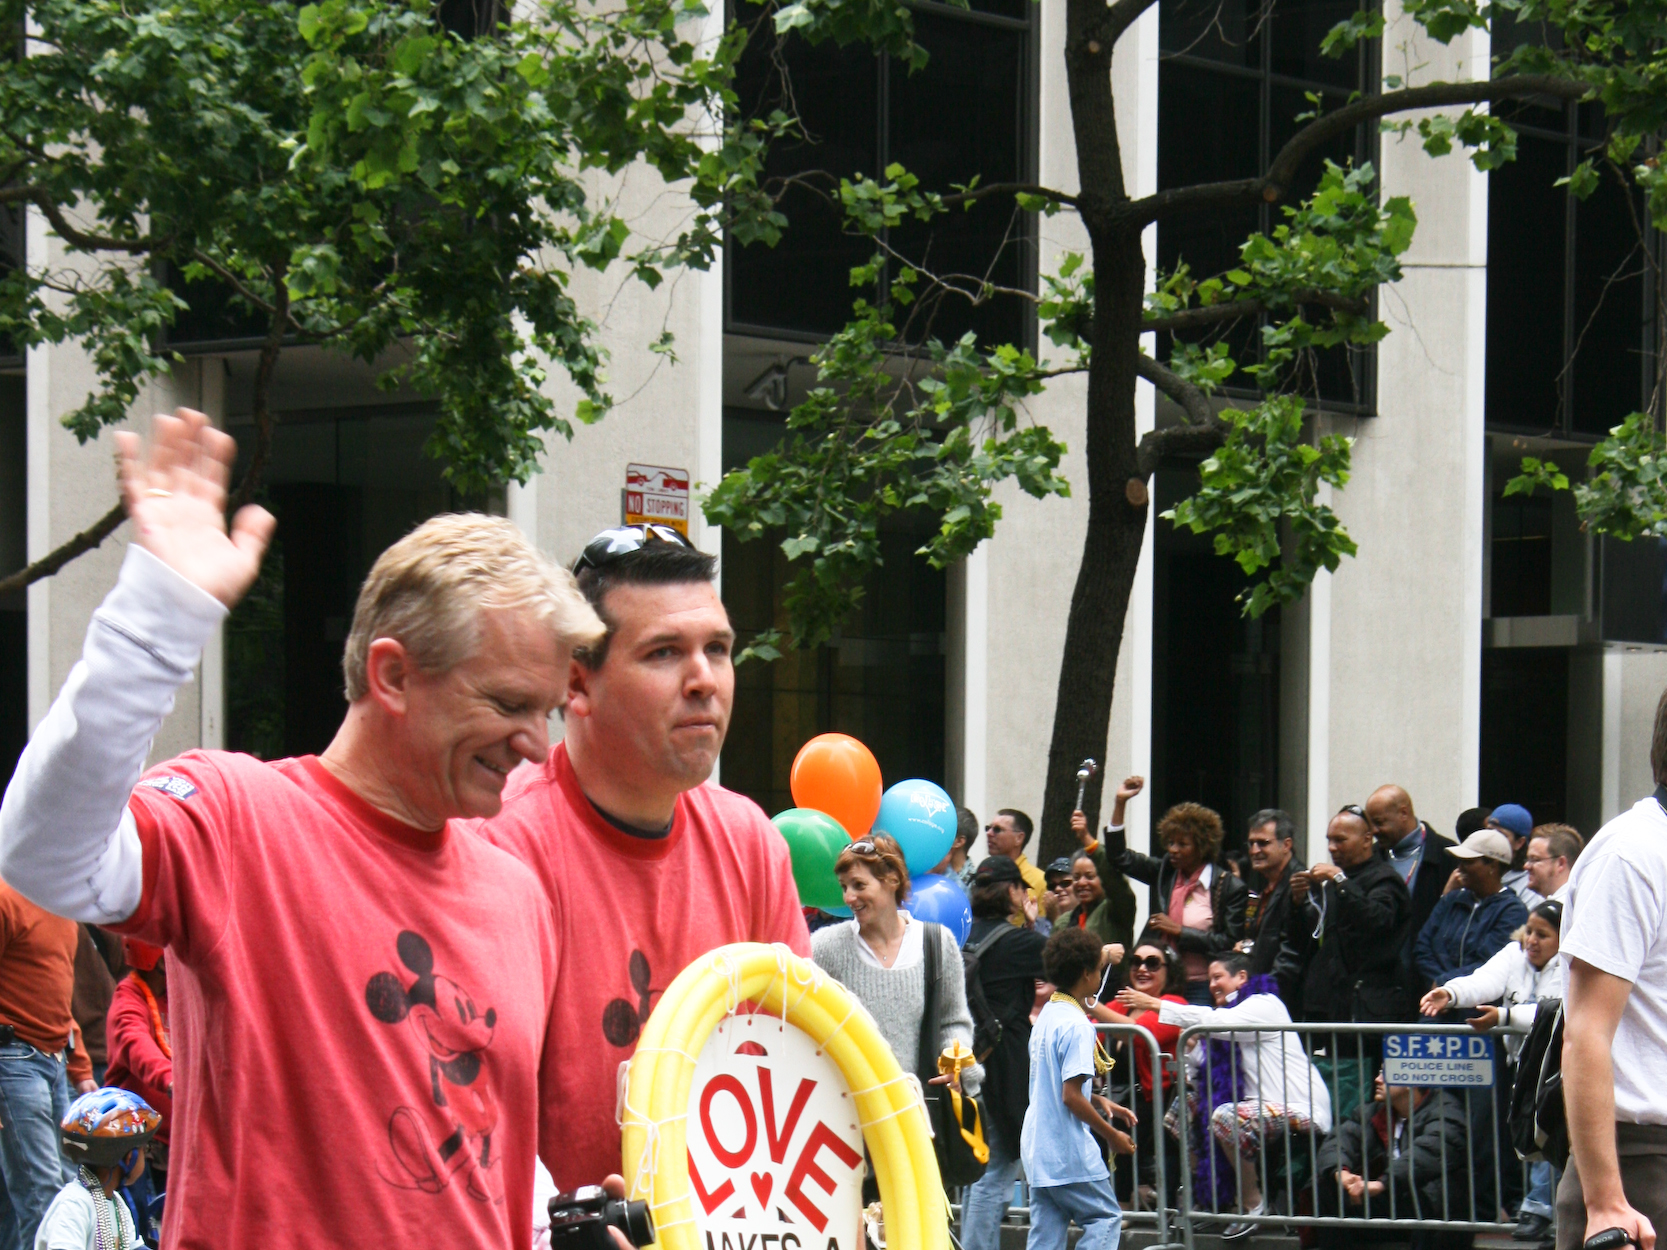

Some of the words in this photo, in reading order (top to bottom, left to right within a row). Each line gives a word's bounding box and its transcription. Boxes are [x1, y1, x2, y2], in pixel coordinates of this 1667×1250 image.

[628, 494, 642, 513] NO
[646, 498, 684, 517] STOPPING
[1401, 1062, 1443, 1070] POLICE
[1447, 1063, 1473, 1071] LINE
[1393, 1073, 1409, 1081] DO
[1412, 1073, 1436, 1082] NOT
[1440, 1074, 1484, 1082] CROSS
[687, 1066, 863, 1234] LOVE
